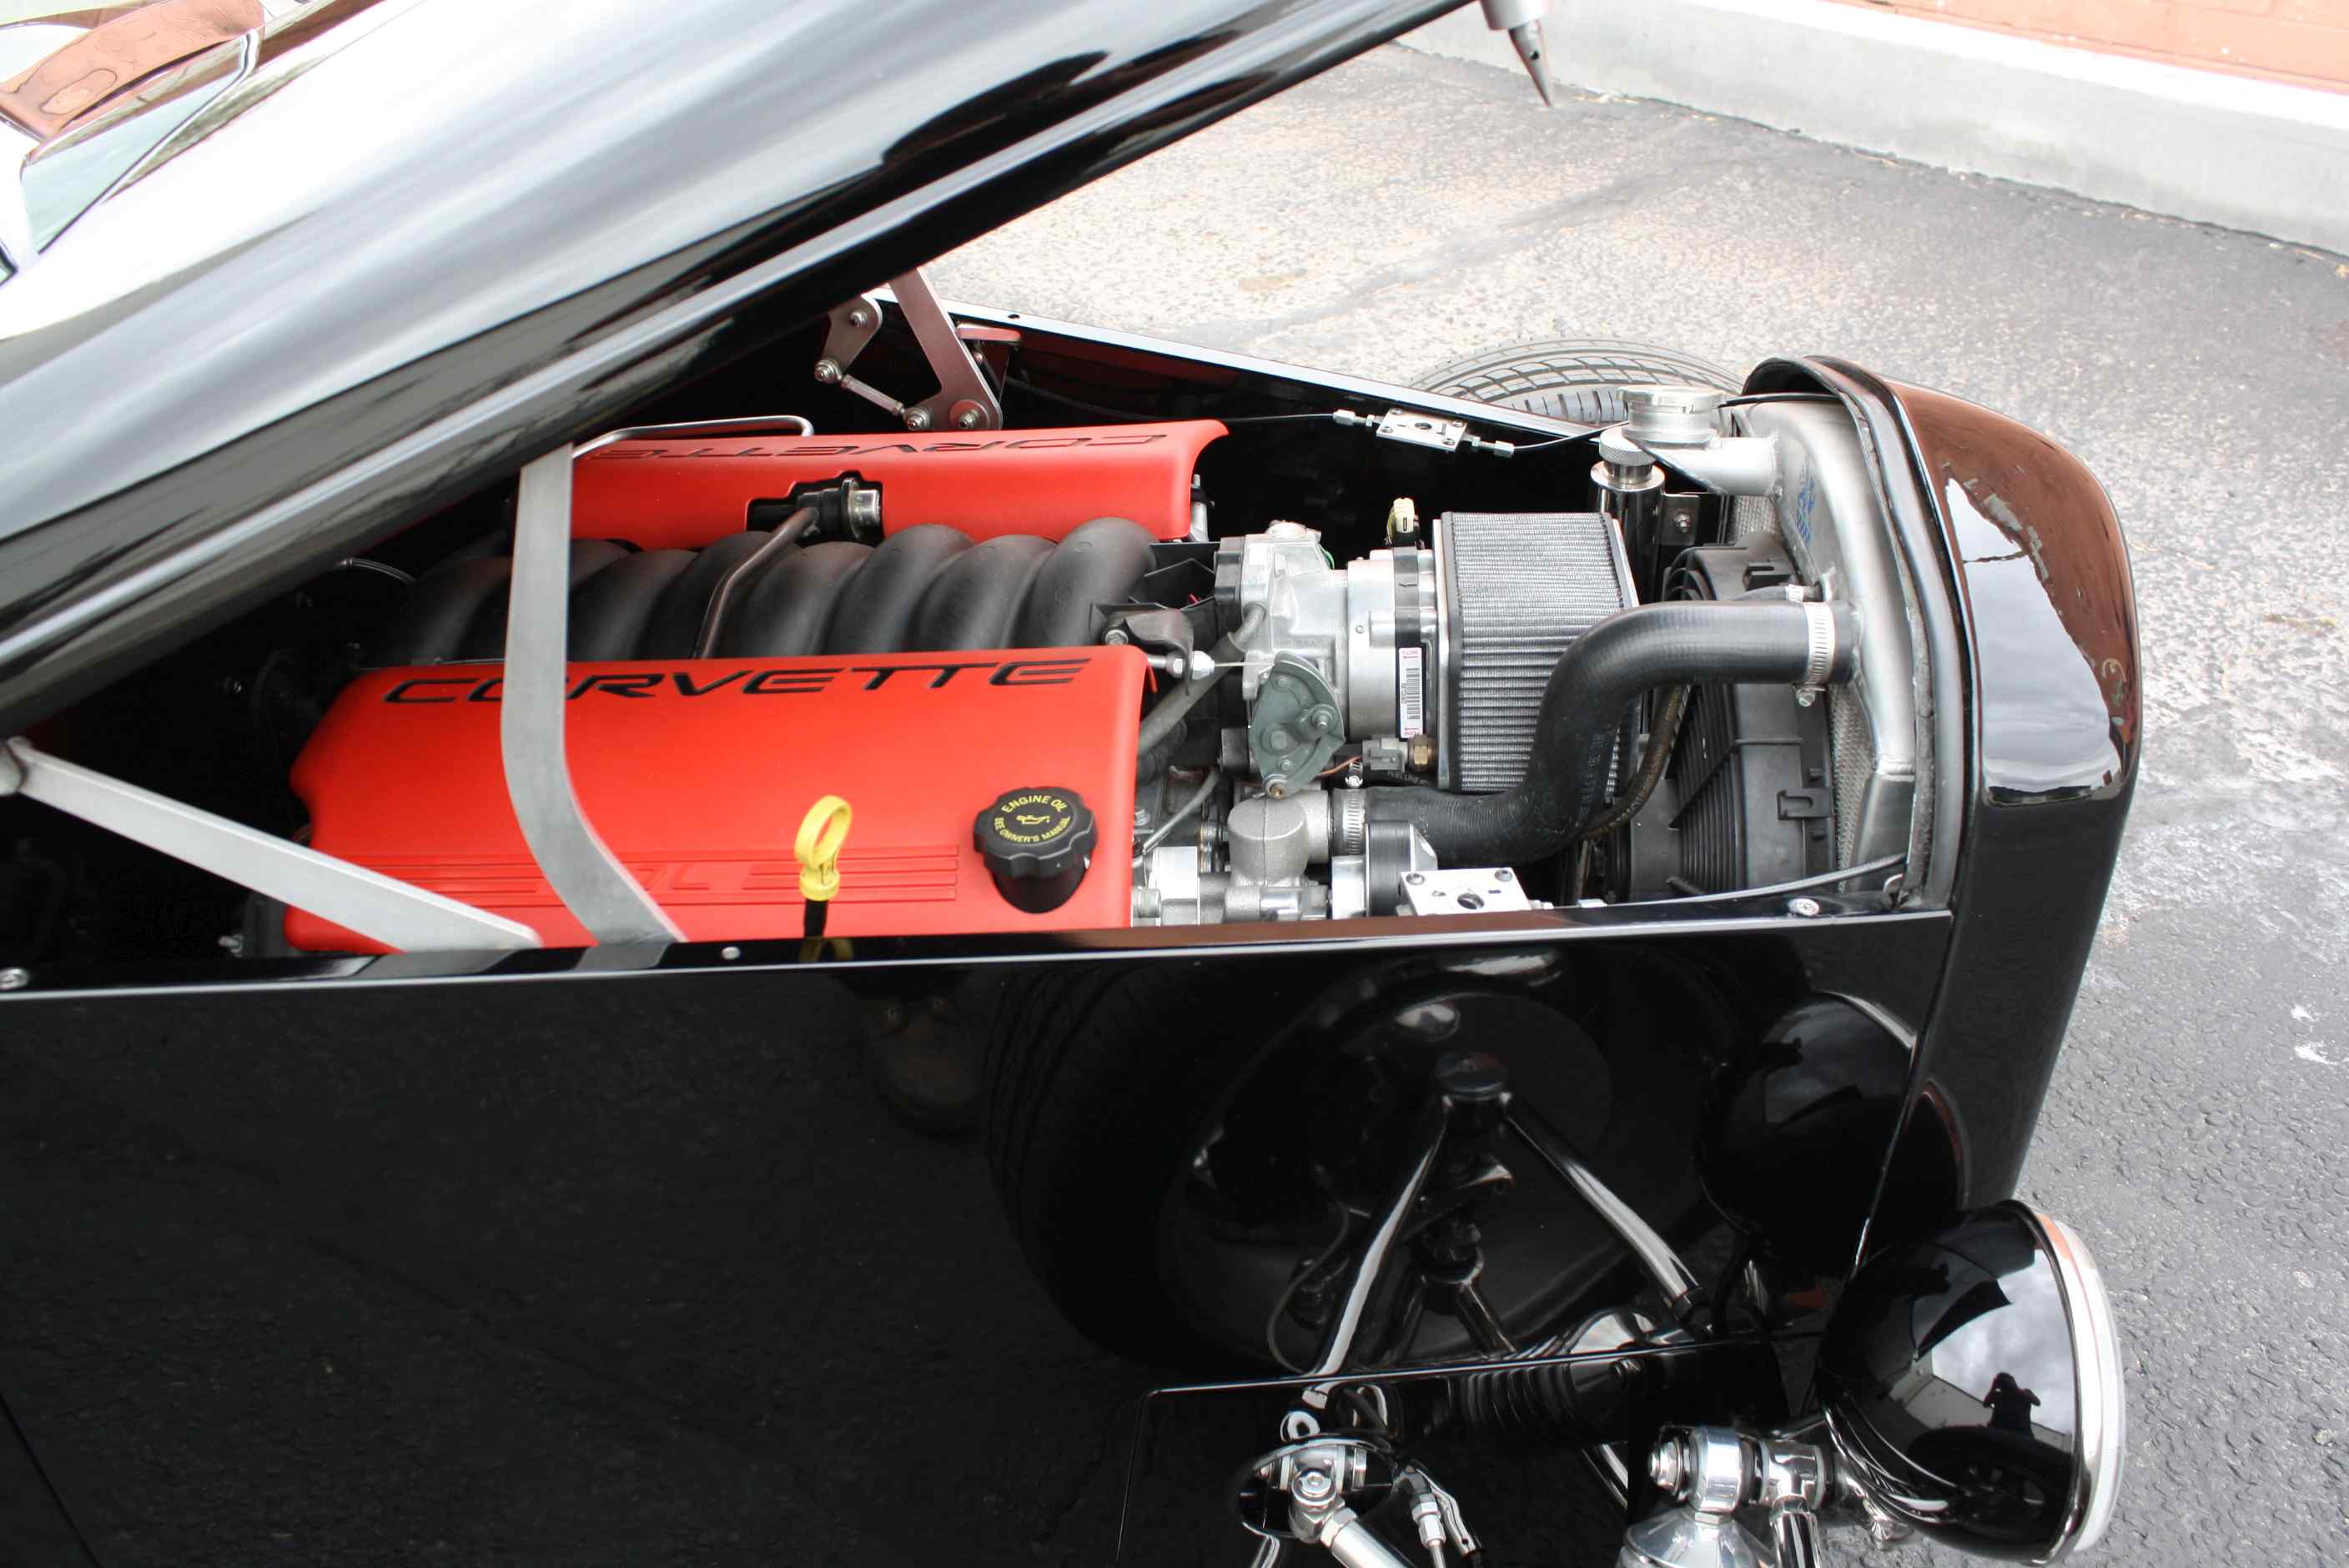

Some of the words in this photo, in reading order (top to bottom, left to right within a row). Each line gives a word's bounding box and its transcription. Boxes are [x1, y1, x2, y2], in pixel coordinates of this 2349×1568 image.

[1001, 795, 1051, 813] ENGINE
[1051, 798, 1067, 812] OIL
[994, 817, 1005, 831] SEE
[1041, 816, 1071, 841] MANUAL
[999, 829, 1040, 843] OWNER'S
